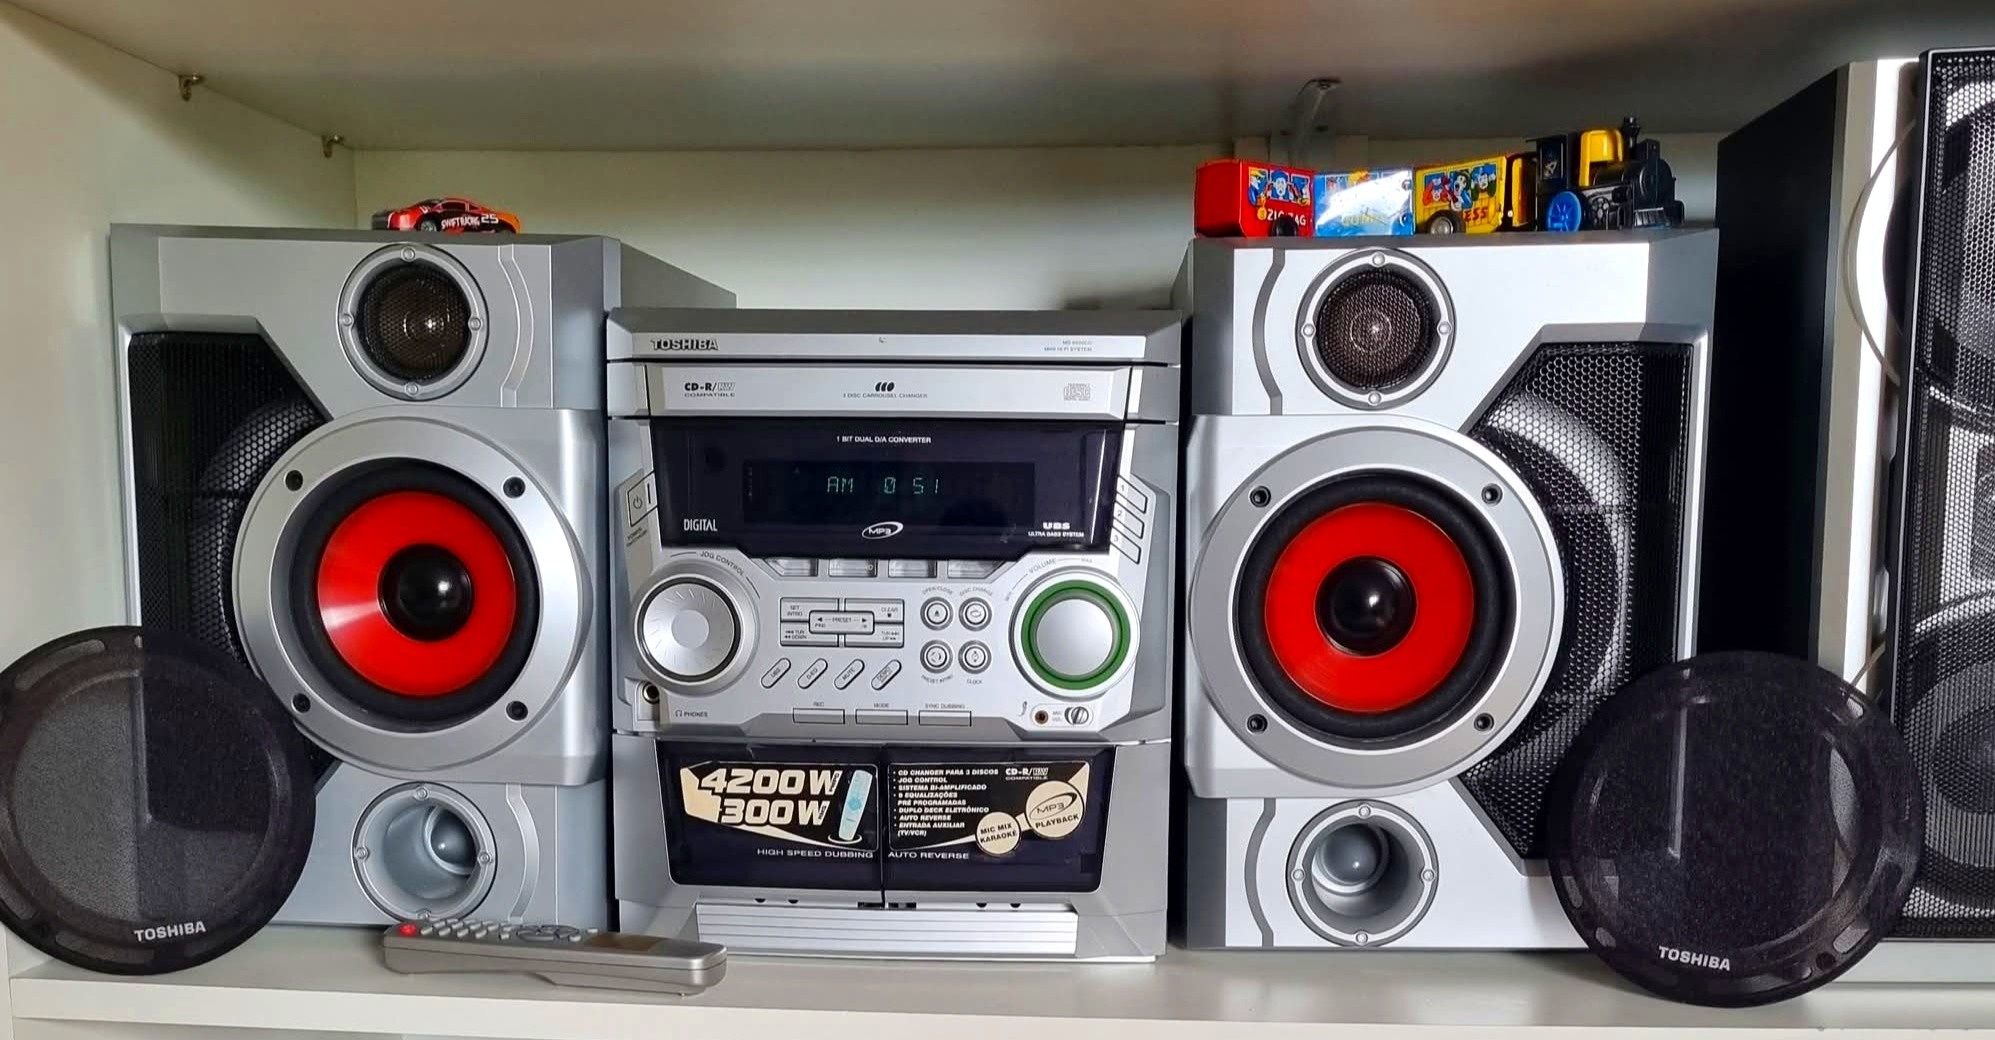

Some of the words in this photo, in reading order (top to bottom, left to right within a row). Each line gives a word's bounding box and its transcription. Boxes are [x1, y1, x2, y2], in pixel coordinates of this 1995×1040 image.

[481, 213, 499, 224] 25
[650, 338, 719, 351] TOSHIBA
[888, 436, 932, 444] CONVERTER
[827, 476, 854, 493] AM
[683, 518, 718, 532] DIGITAL
[1042, 522, 1071, 530] UBS
[868, 527, 892, 536] MP3
[700, 550, 715, 560] JOG
[715, 554, 745, 576] CONTROL
[1028, 557, 1057, 574] VOLUME
[842, 667, 856, 681] MUTE
[1005, 767, 1049, 776] CD-R/RW
[905, 791, 958, 799] EQUALIZAÇÕES
[945, 805, 990, 813] ELETRÔNICO
[1036, 802, 1065, 814] MP3
[1035, 813, 1080, 829] PLAYBACK
[897, 829, 927, 838] (TV/VCR)
[980, 826, 996, 834] MIC
[997, 823, 1012, 831] MIX
[757, 848, 784, 857] HIGH
[786, 849, 822, 858] SPEED
[824, 850, 874, 859] DUBBING
[887, 850, 918, 859] AUTO
[920, 851, 970, 860] REVERSE
[134, 921, 206, 942] TOSHIBA
[1659, 945, 1731, 972] TOSHIBA
